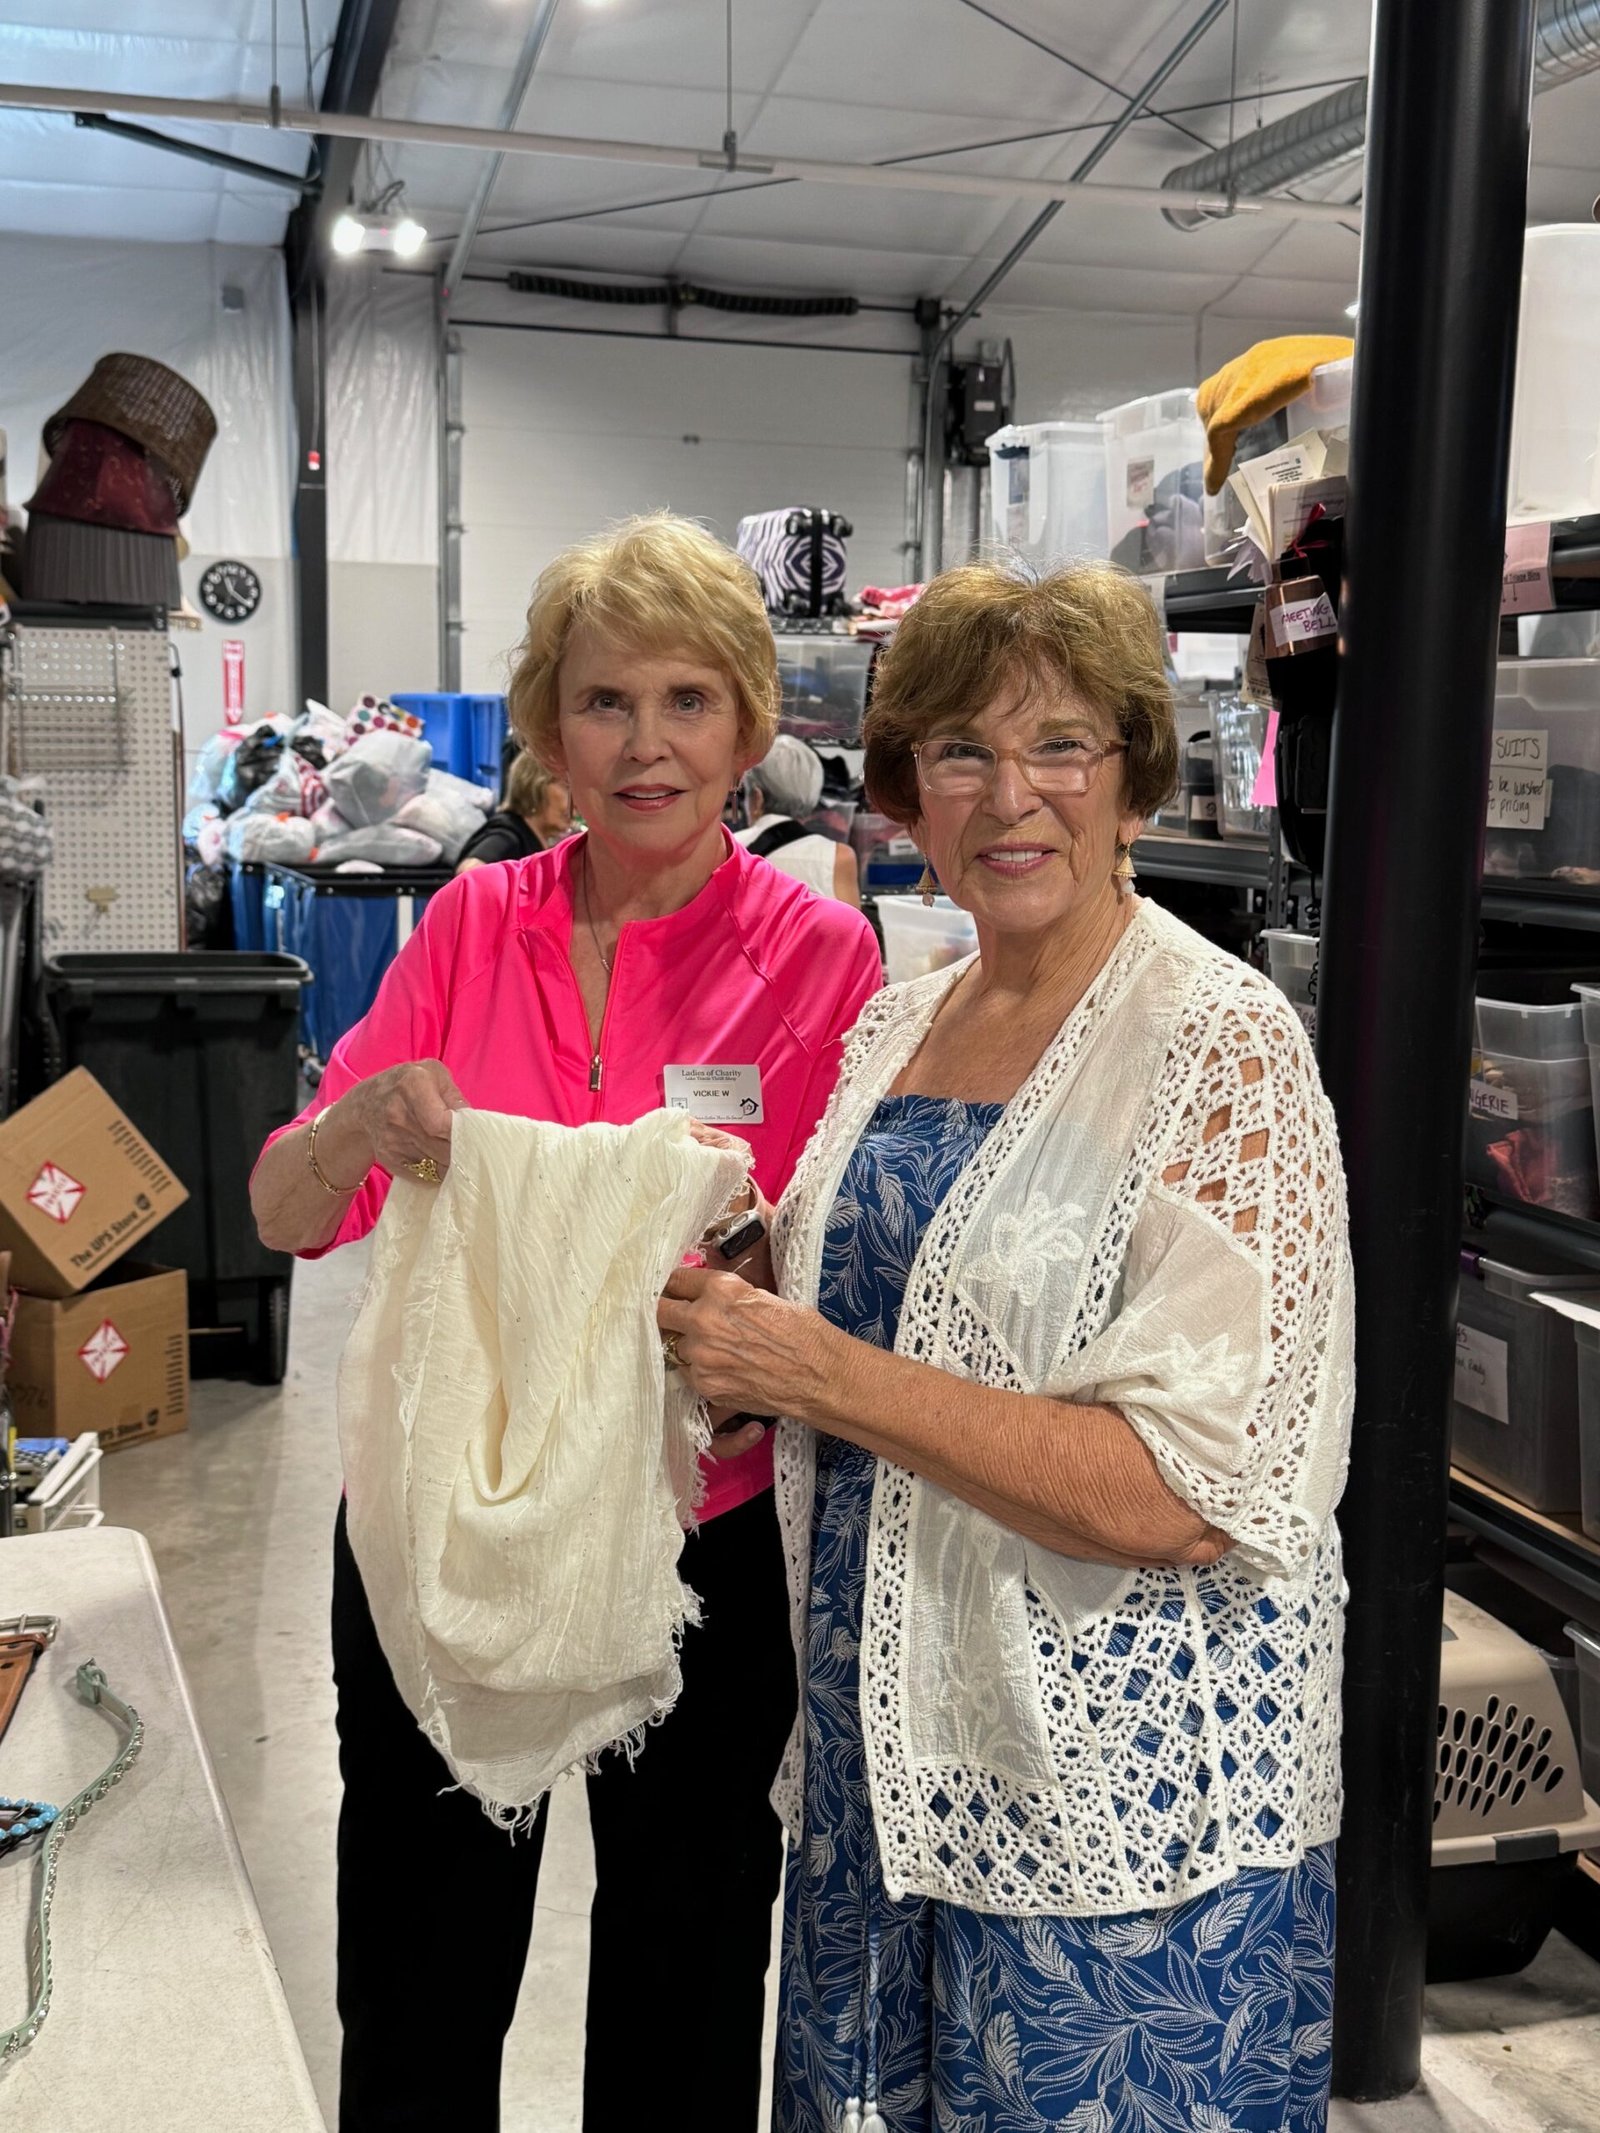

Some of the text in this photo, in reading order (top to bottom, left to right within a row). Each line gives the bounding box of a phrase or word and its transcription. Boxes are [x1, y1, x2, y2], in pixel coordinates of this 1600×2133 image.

[1281, 603, 1330, 624] MEETING
[1303, 619, 1337, 632] BELL
[1495, 736, 1541, 760] SUITS
[1499, 797, 1530, 824] pricing
[681, 1069, 742, 1078] Ladies of Charity
[69, 1210, 139, 1267] The UPS Store
